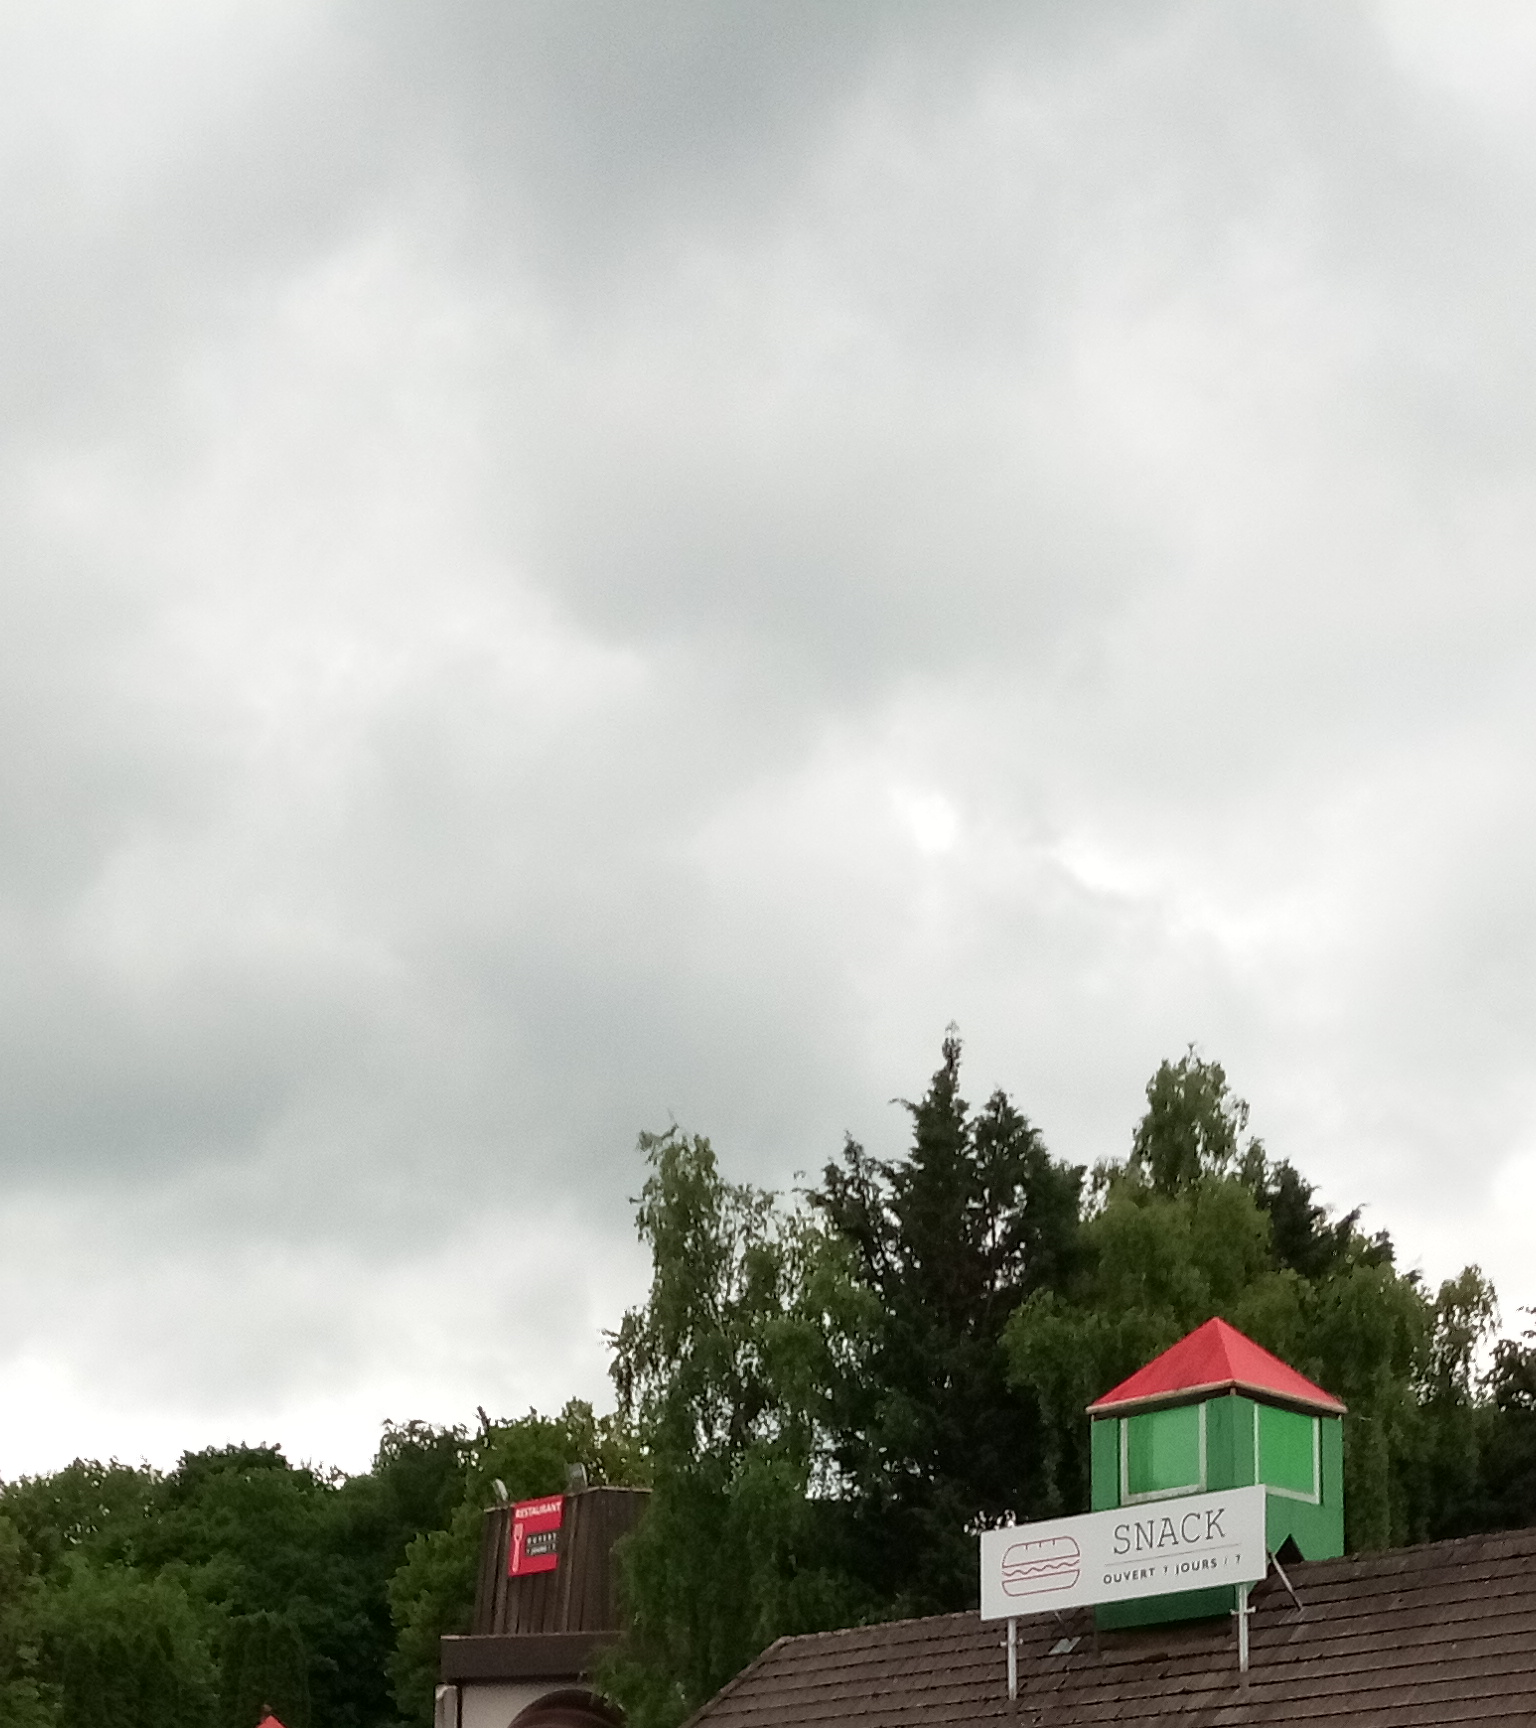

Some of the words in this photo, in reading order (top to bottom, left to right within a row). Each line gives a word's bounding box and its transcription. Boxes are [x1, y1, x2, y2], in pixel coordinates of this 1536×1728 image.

[1113, 1508, 1226, 1554] SNACK
[1103, 1567, 1155, 1584] OUVERT
[1175, 1558, 1217, 1577] JOURS
